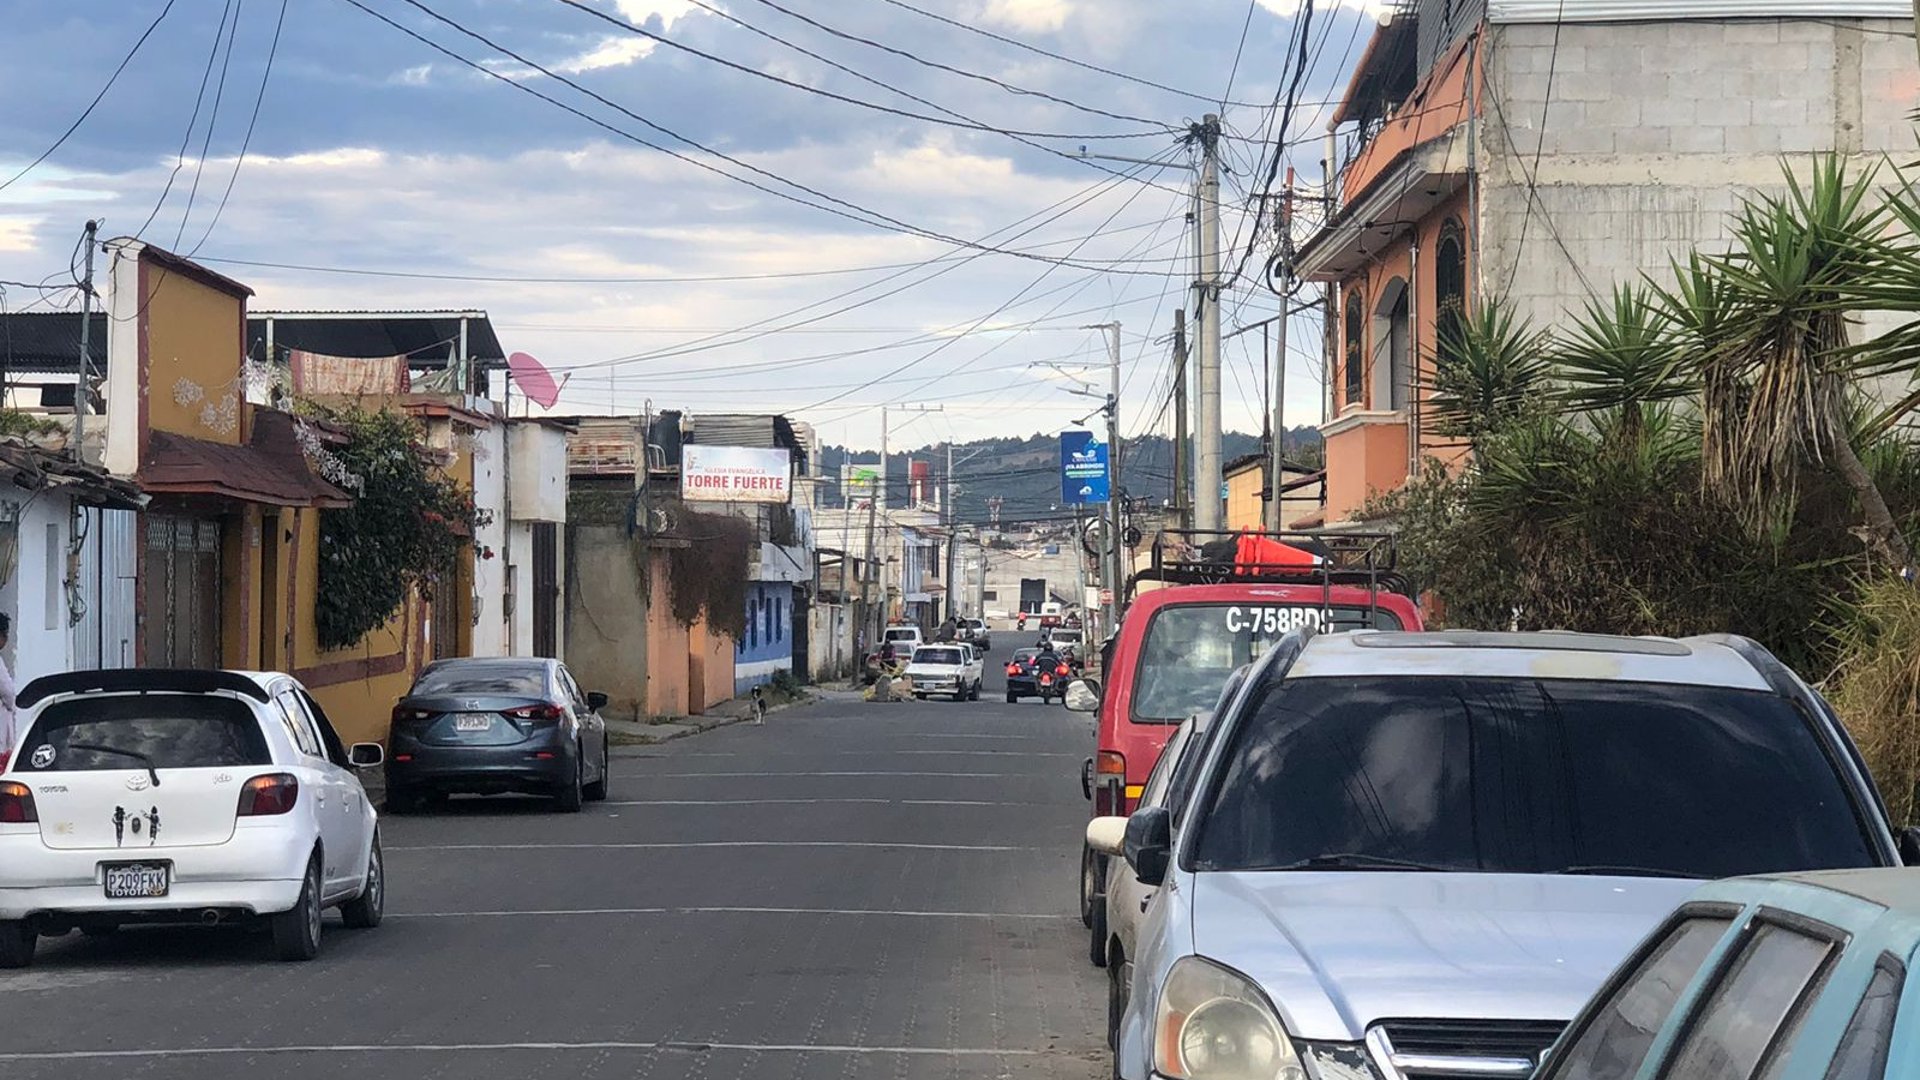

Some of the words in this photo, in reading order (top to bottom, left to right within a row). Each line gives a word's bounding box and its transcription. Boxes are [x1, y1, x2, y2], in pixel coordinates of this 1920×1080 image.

[687, 475, 730, 488] TORRE
[734, 476, 784, 490] FUERTE
[1226, 606, 1334, 634] C-758BDS
[109, 872, 164, 890] P209FKK
[111, 888, 149, 897] TOYOTA
